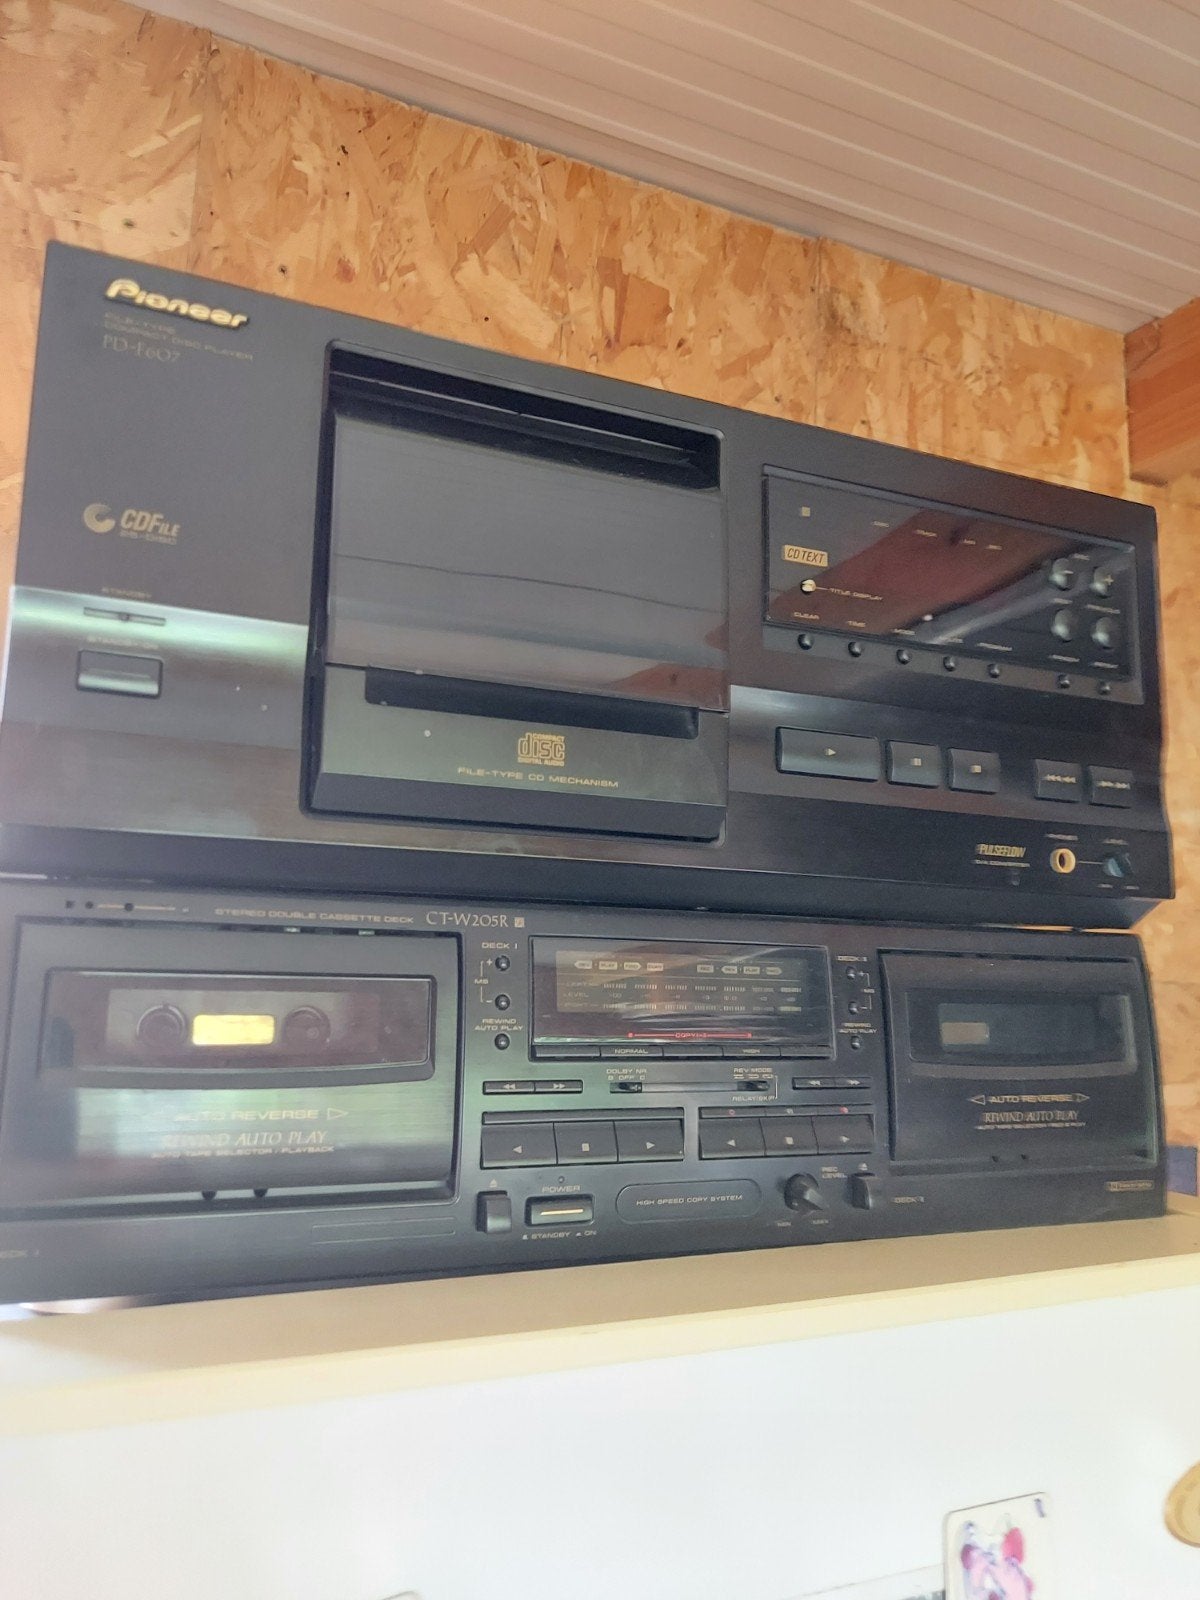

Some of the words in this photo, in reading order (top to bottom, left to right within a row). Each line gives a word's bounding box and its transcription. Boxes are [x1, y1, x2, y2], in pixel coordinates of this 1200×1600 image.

[106, 278, 248, 327] Pioneer
[457, 766, 524, 781] FILE-TYPE
[528, 773, 545, 782] CD
[548, 775, 619, 788] MECHANISM
[215, 908, 267, 918] STEREO
[268, 910, 317, 920] DOUBLE
[319, 912, 381, 923] CASSETTE
[384, 915, 414, 924] DECK
[425, 911, 509, 928] CT-W205R
[230, 1109, 320, 1121] REVERSE
[235, 1131, 283, 1147] AUTO
[287, 1130, 329, 1145] PLAY
[541, 1185, 581, 1193] POWER
[657, 1197, 684, 1205] SPEED
[531, 1231, 571, 1240] STANDBY
